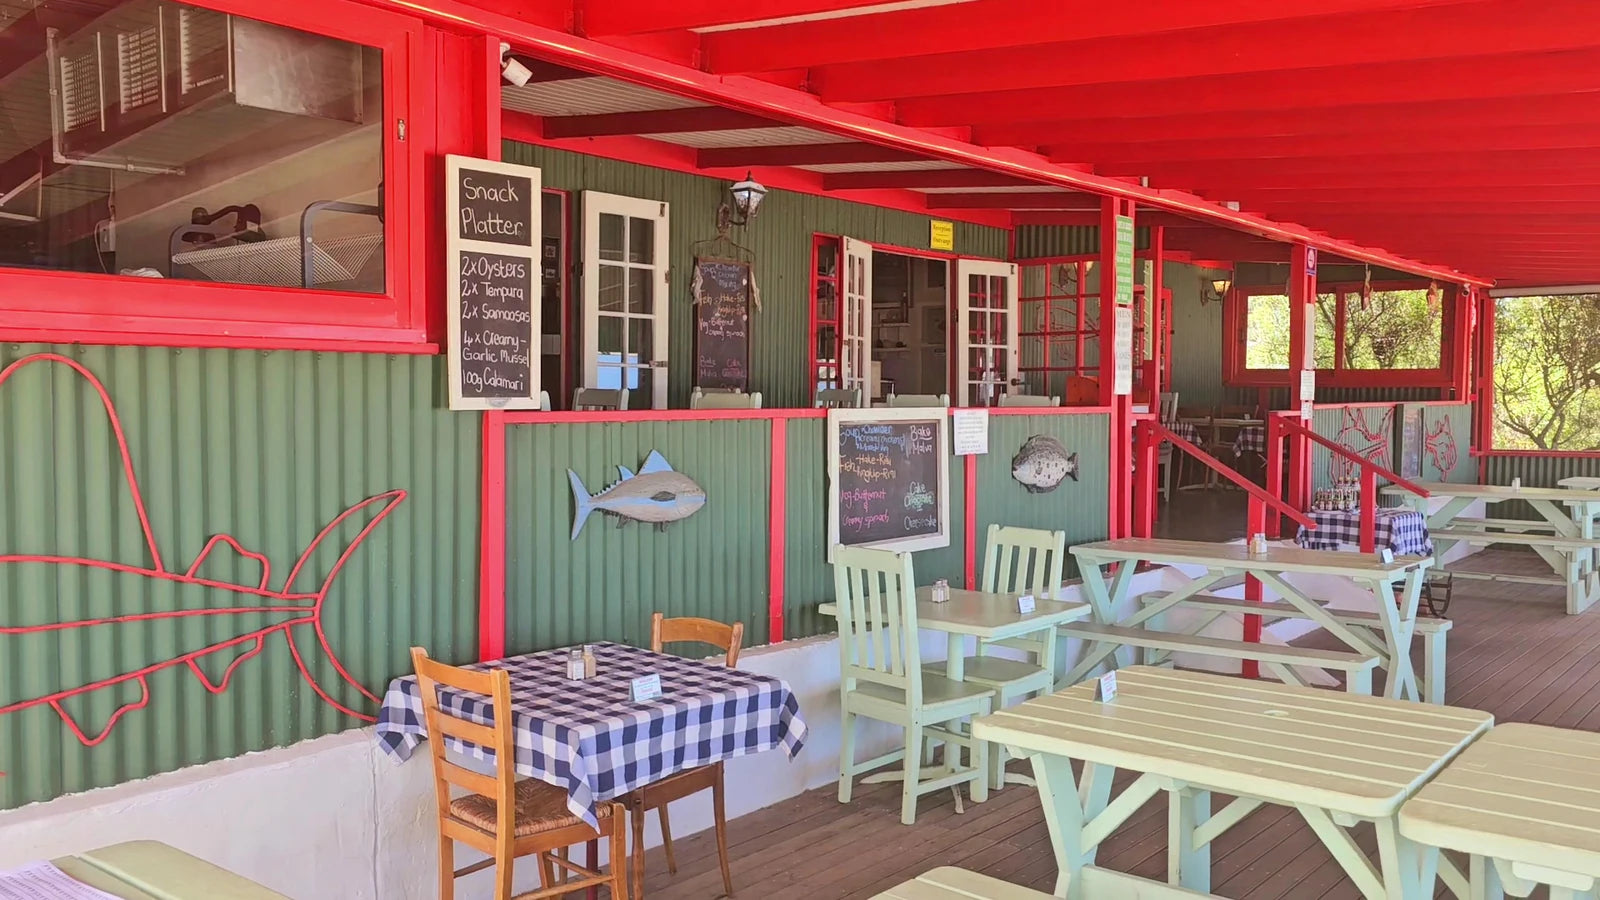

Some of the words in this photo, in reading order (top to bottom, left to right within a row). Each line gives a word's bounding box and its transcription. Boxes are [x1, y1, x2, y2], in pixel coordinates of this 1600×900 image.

[463, 177, 519, 203] Snack
[461, 207, 523, 236] Platter
[461, 279, 479, 298] 2x
[480, 281, 524, 303] Tempura
[461, 301, 479, 319] 2x
[481, 303, 531, 322] Samoosas
[462, 348, 498, 363] Garlic
[910, 425, 932, 441] Bake
[912, 441, 933, 455] Malva
